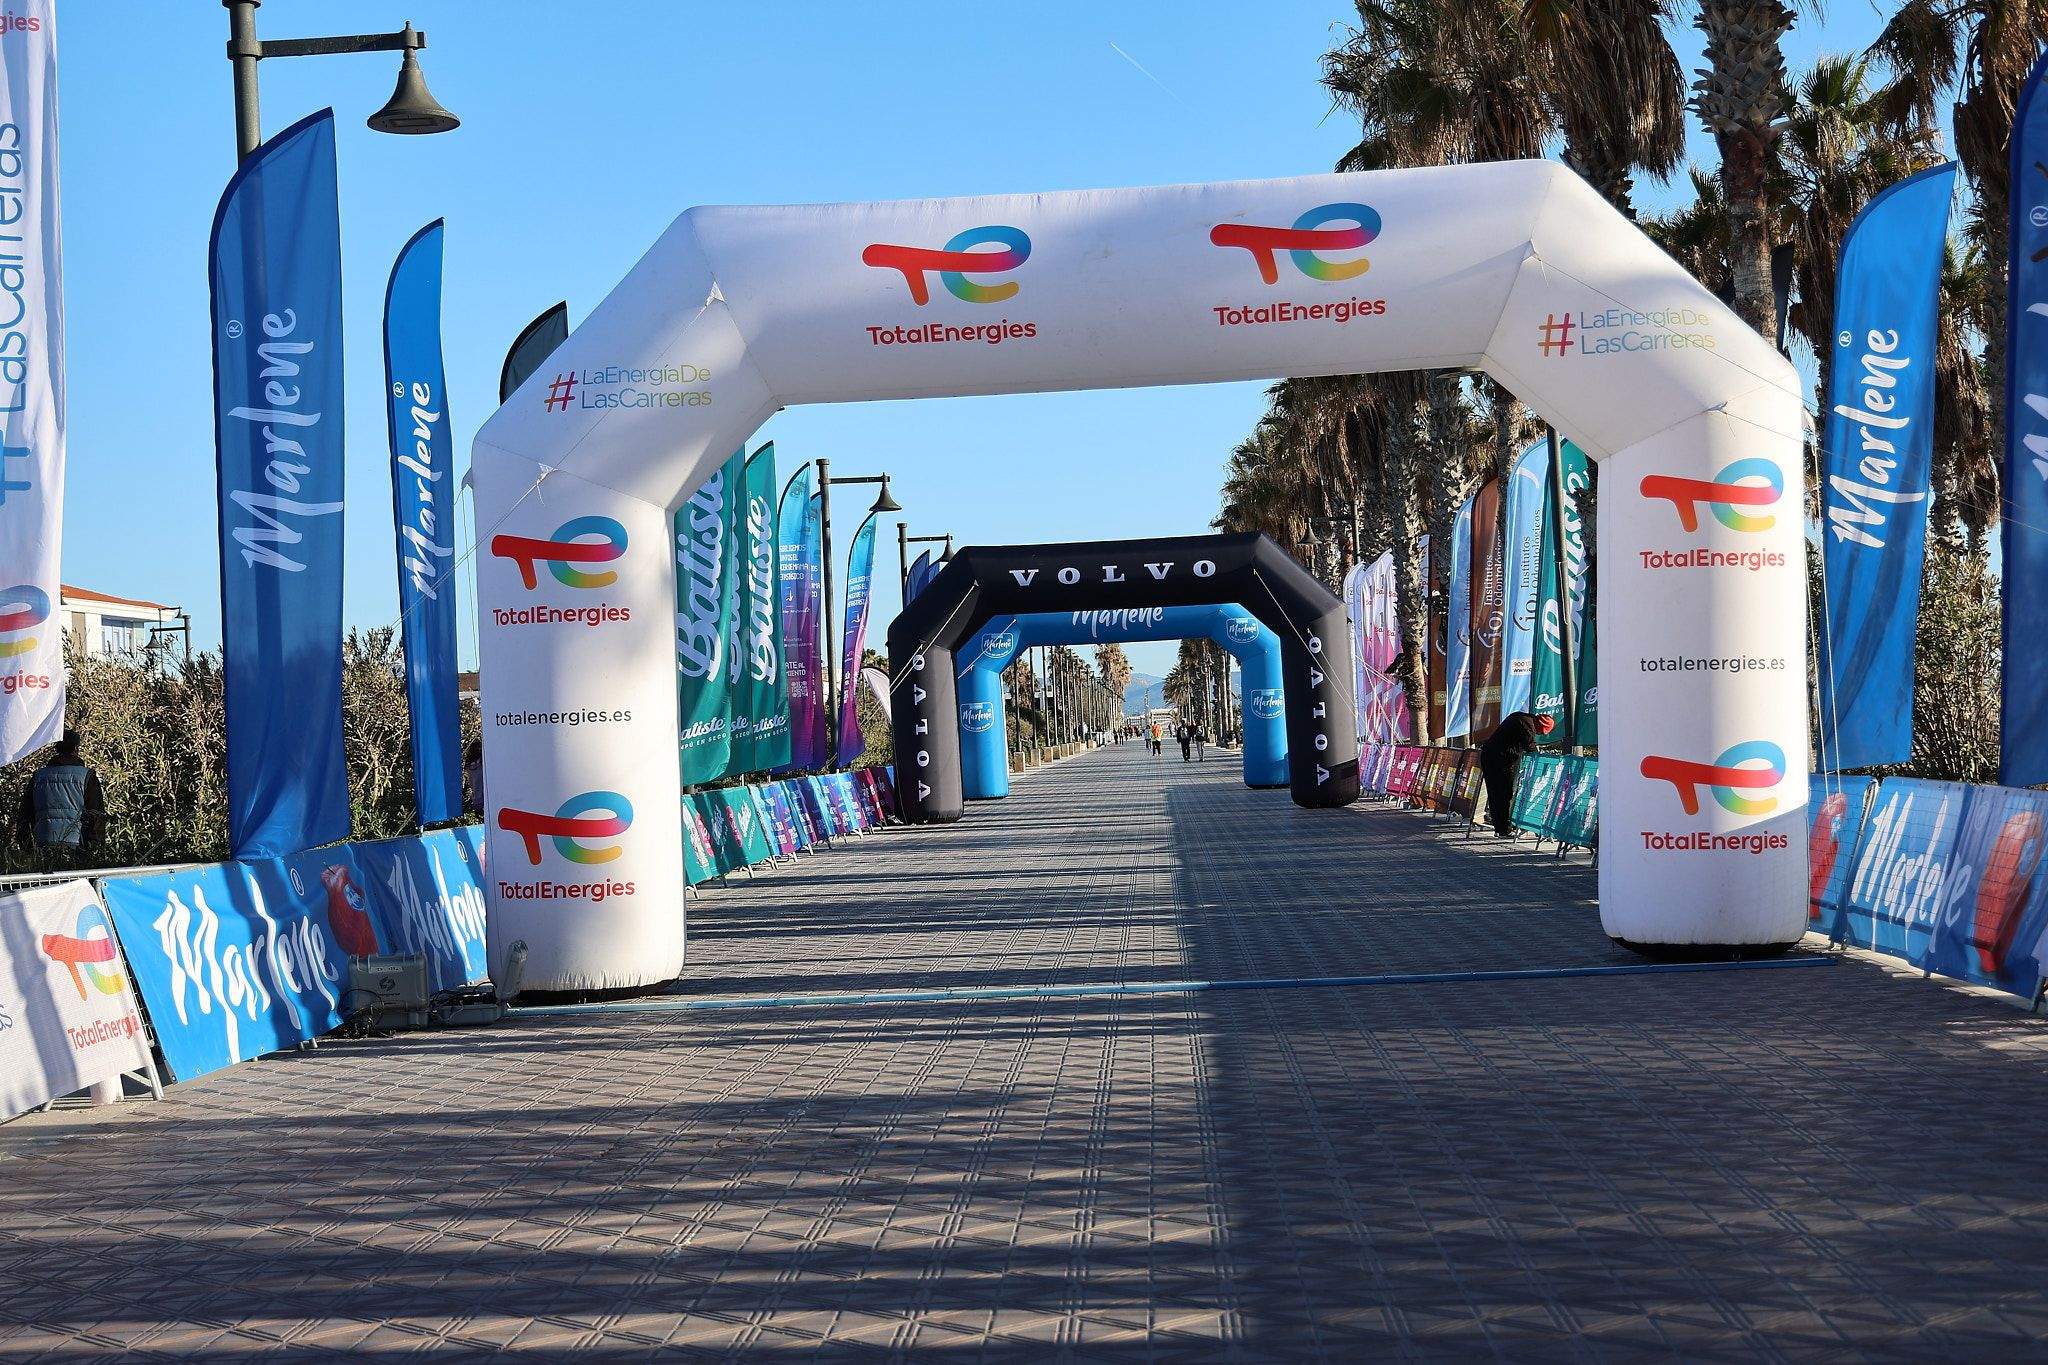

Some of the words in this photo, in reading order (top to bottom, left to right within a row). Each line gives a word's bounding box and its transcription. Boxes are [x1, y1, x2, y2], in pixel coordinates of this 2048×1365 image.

[1214, 296, 1387, 326] TotalEnergies
[866, 318, 1038, 346] TotalEnergies
[1581, 330, 1717, 355] LasCarreras
[581, 388, 713, 409] LasCarreras
[232, 308, 344, 572] Marlene
[1829, 329, 1926, 548] Marlene
[398, 381, 456, 600] Marlene
[1009, 559, 1217, 587] VOLVO
[1640, 548, 1786, 571] TotalEnergies
[1484, 554, 1494, 606] Institutos
[493, 603, 631, 626] TotalEnergies
[1640, 655, 1786, 674] totalenergies.es
[496, 708, 633, 727] totalenergies.es
[753, 715, 786, 733] atiste
[1308, 636, 1330, 786] VOLVO
[681, 716, 726, 741] atiste
[912, 654, 931, 802] VOLVO
[1640, 832, 1788, 855] TotalEnergies
[1851, 791, 1972, 954] Marlene
[499, 877, 636, 902] TotalEnergies
[153, 873, 339, 1064] Marlene
[67, 1009, 140, 1050] TotalEnergi
